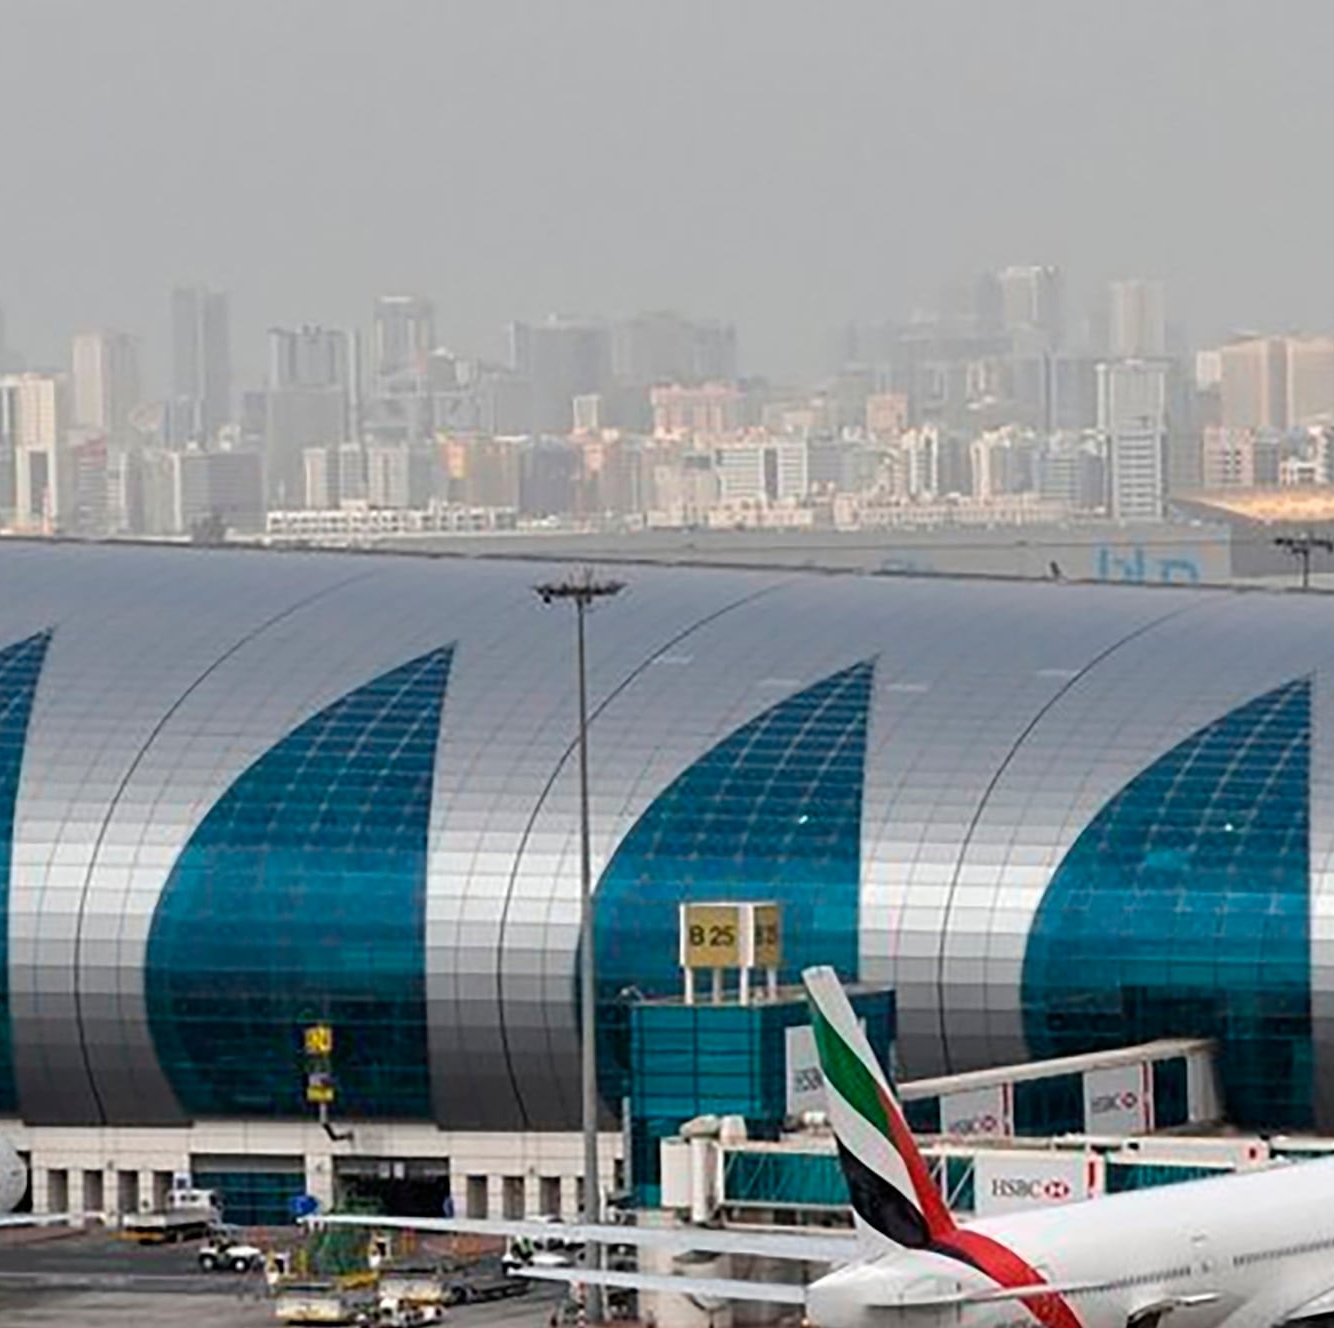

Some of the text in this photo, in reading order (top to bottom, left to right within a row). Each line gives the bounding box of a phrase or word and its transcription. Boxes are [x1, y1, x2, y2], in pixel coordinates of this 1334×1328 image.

[689, 925, 705, 946] B
[710, 925, 735, 946] 25
[992, 1178, 1043, 1199] HSBC
